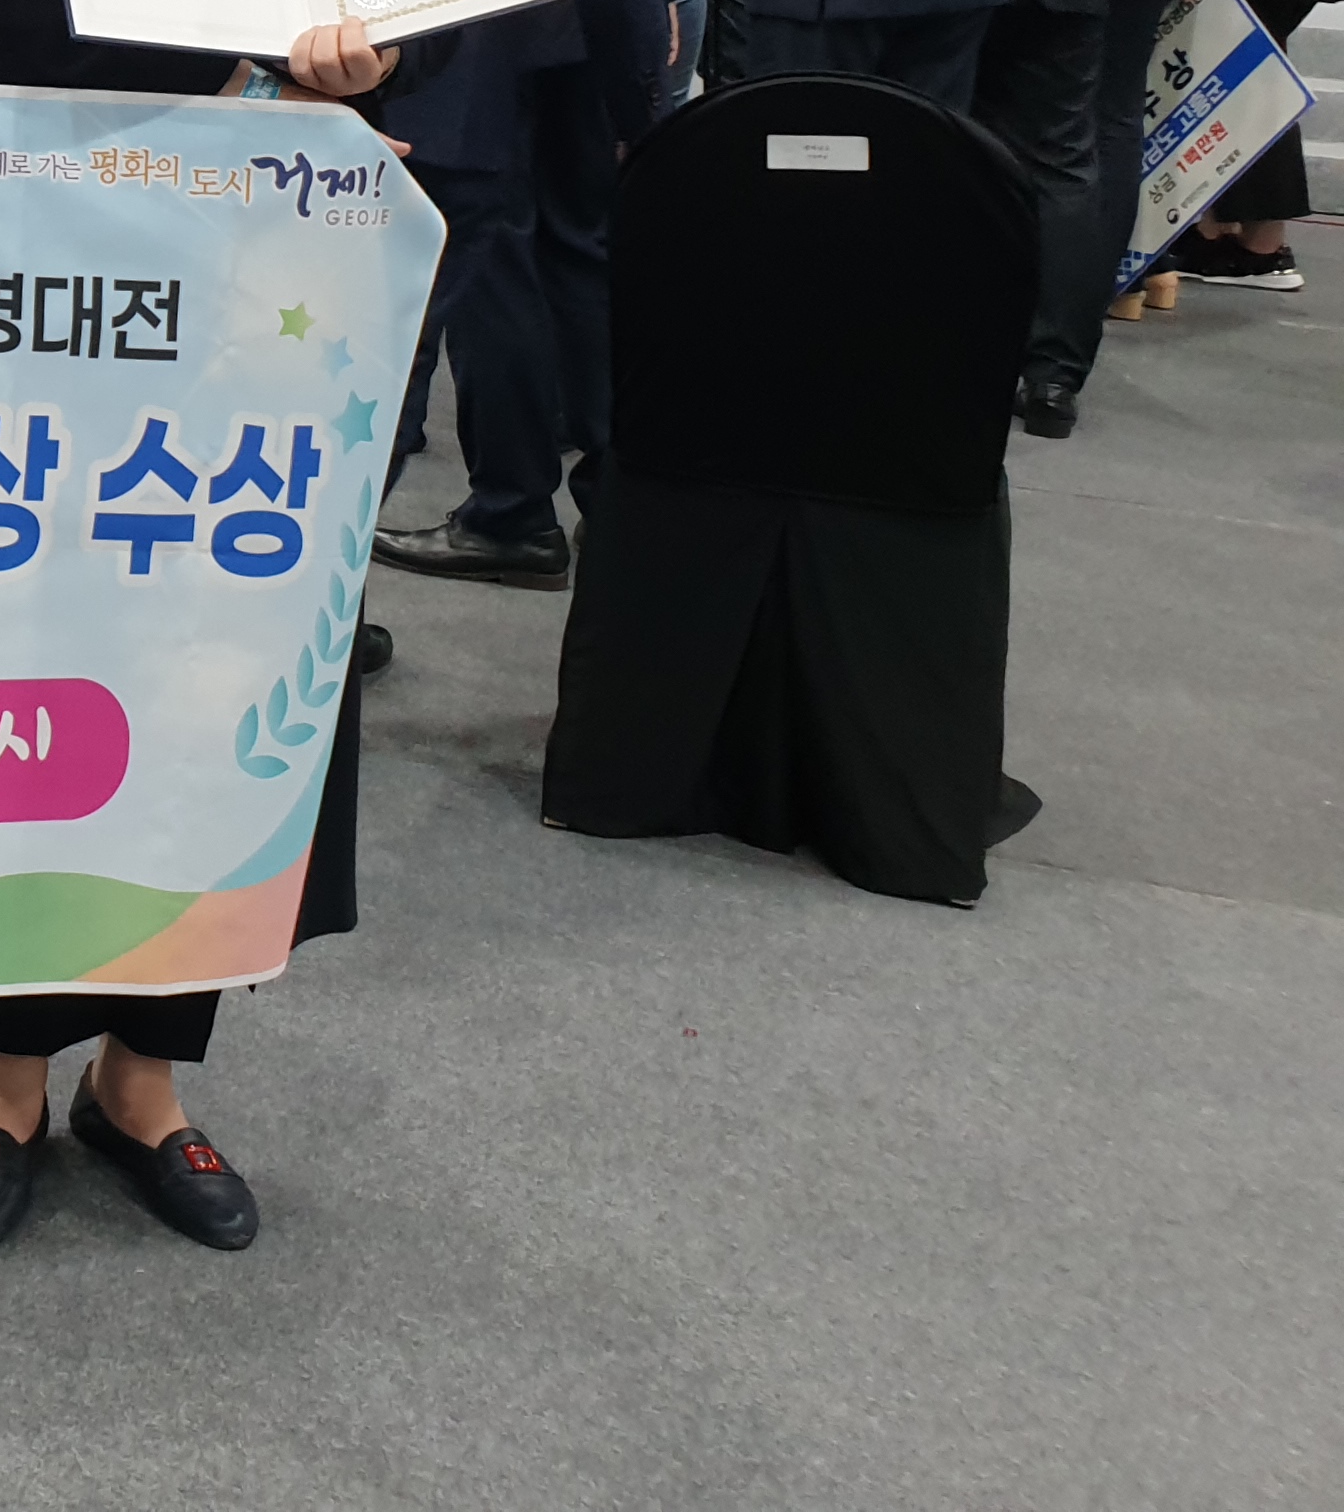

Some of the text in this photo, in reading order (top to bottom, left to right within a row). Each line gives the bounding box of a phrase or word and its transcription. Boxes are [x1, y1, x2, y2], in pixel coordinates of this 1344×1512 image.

[1172, 74, 1228, 134] 고흥군
[38, 154, 82, 181] 가는
[89, 147, 179, 187] 평화의
[189, 166, 252, 204] 도시
[1148, 172, 1177, 205] 상금
[1176, 119, 1229, 173] 1백만원
[325, 208, 390, 227] GEOJE
[91, 416, 322, 578] 수상
